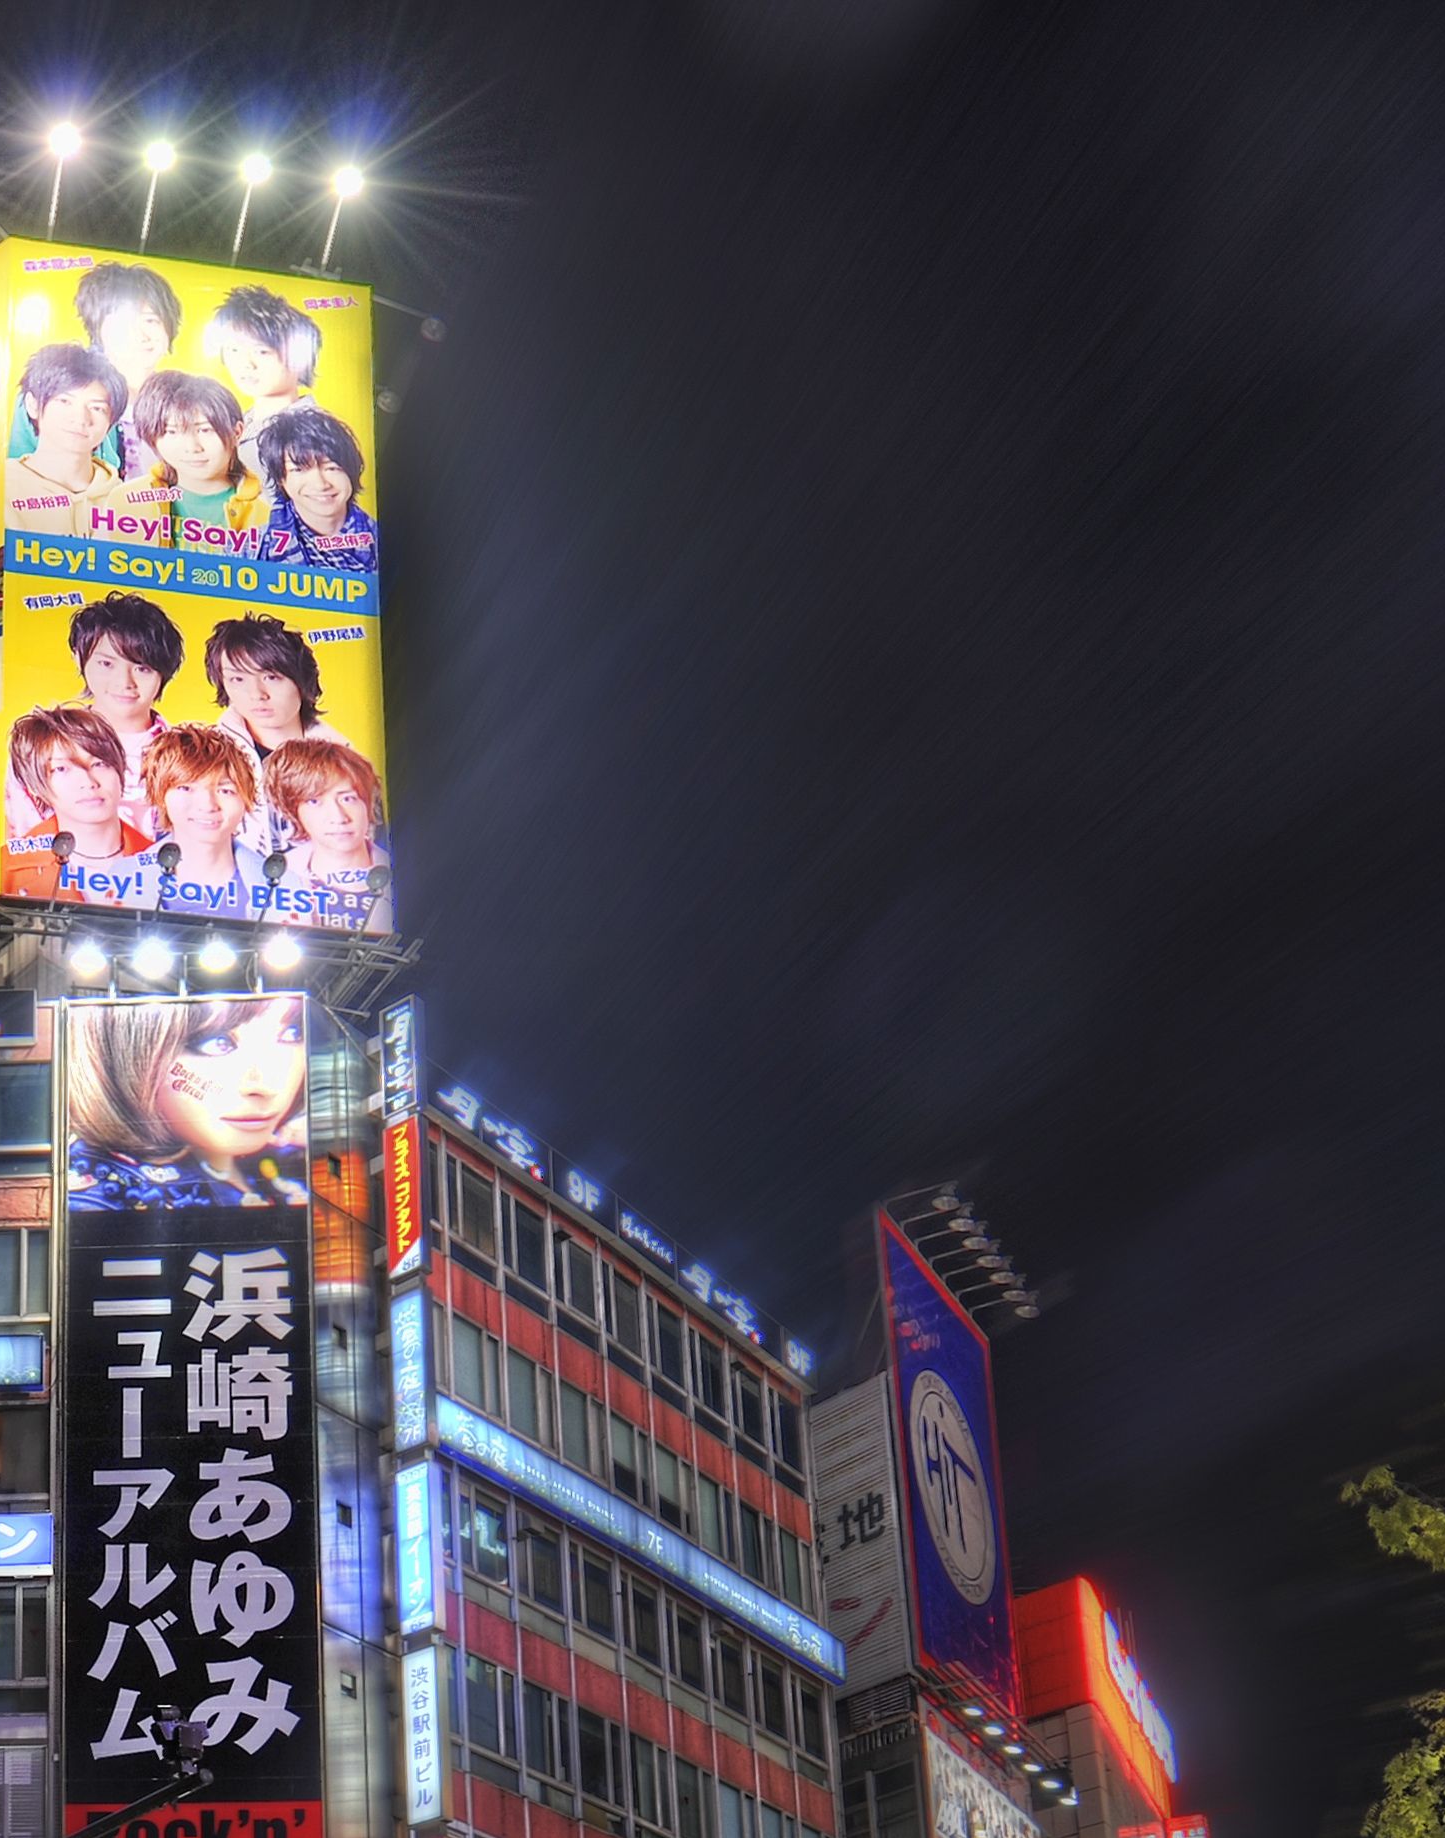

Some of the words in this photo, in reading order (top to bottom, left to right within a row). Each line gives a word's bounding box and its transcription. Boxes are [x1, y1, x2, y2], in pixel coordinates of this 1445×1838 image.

[12, 495, 70, 512] 中島裕翔
[91, 508, 170, 540] Hey!
[183, 519, 258, 552] Say!
[272, 532, 290, 553] 7
[15, 538, 96, 574] Hey!
[109, 551, 185, 584] Say!
[191, 564, 258, 592] 2010
[267, 572, 368, 602] JUMP
[24, 592, 84, 610] 有岡大貴
[307, 625, 365, 643] 伊野尾慧
[60, 864, 144, 897] Hey!
[157, 874, 236, 908] Say!
[251, 884, 332, 915] BEST
[437, 1086, 535, 1169] 月の宴
[567, 1170, 600, 1212] 9F
[786, 1339, 813, 1377] 9F
[404, 1426, 421, 1444] 7F
[86, 1258, 179, 1760] ニューアルバム
[181, 1247, 301, 1756] 浜崎あゆみ
[647, 1531, 663, 1555] 7F
[410, 1666, 434, 1808] 渋谷駅前ビル
